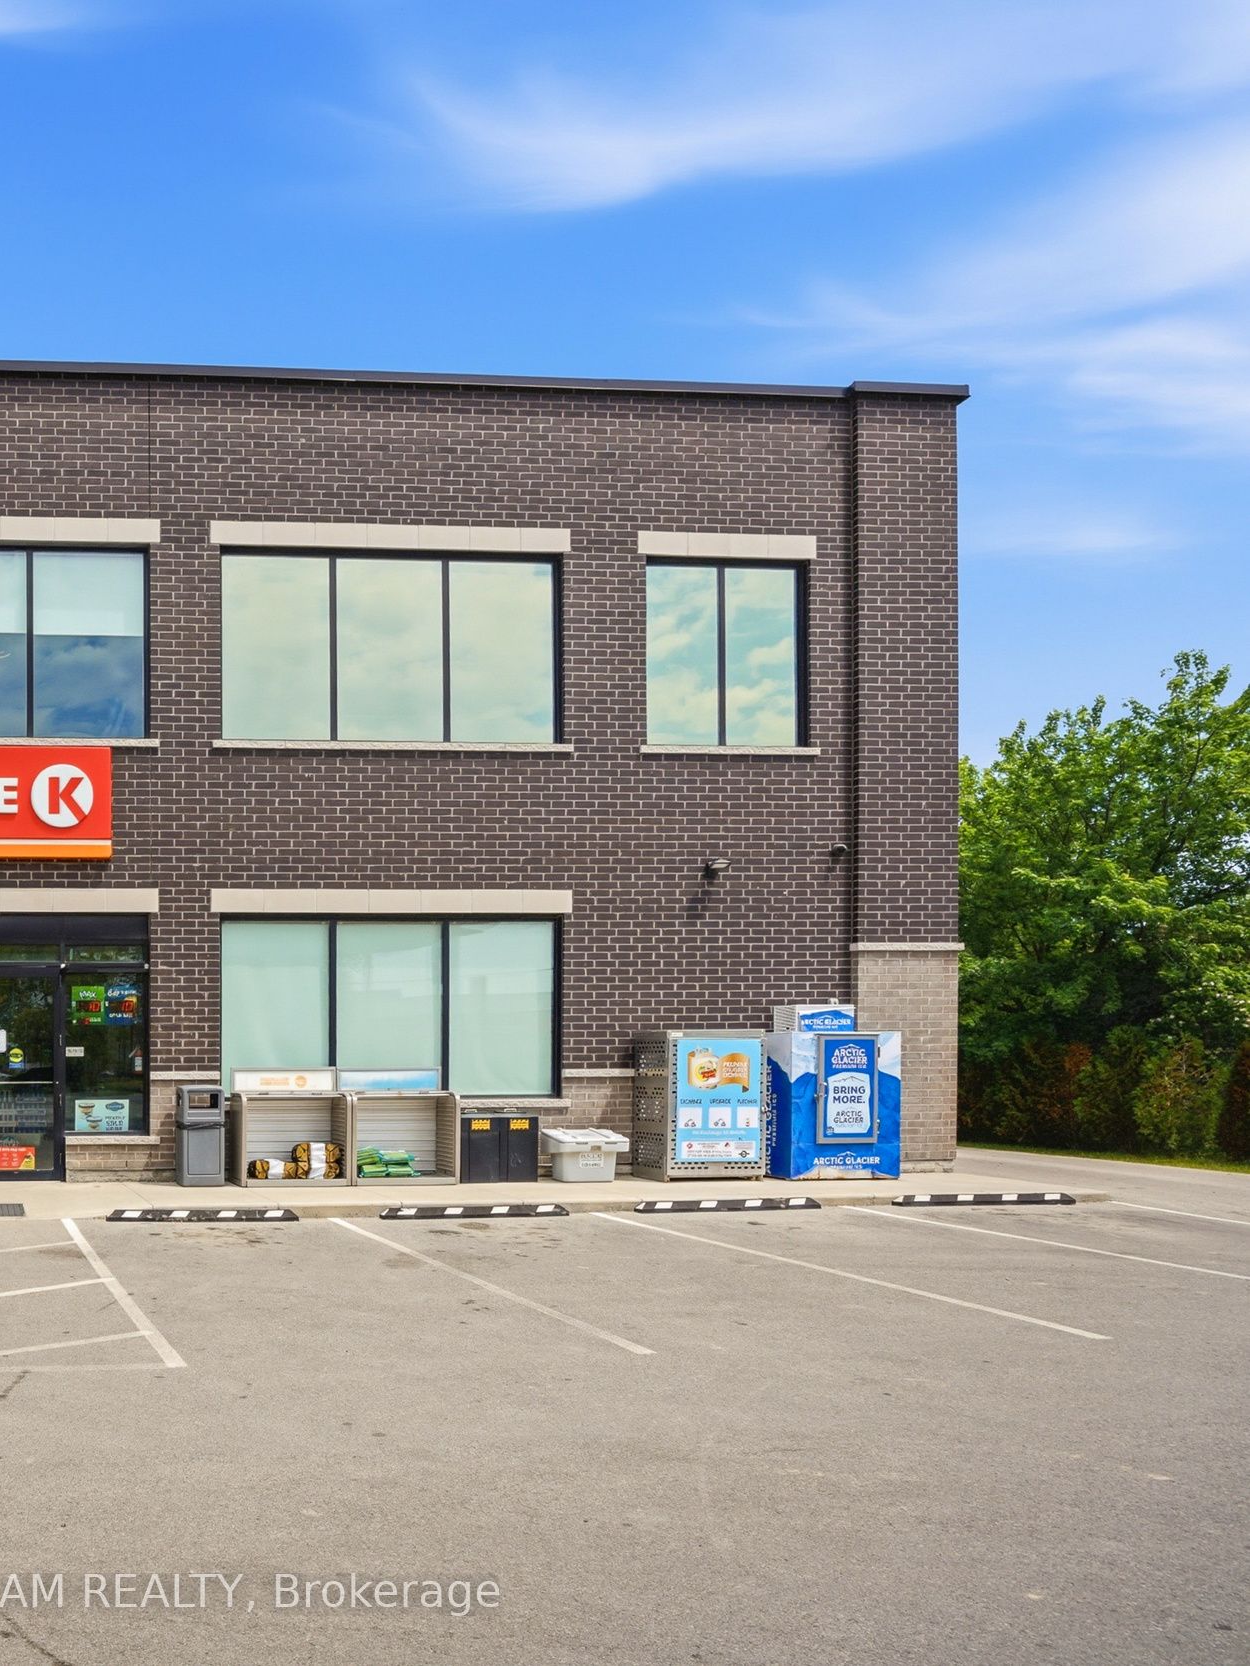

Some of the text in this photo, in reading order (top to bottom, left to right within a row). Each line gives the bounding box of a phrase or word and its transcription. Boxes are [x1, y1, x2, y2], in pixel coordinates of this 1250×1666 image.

[47, 776, 88, 825] K
[832, 1056, 867, 1064] GLACIER
[833, 1086, 866, 1094] BRING
[833, 1096, 866, 1104] MORE.
[845, 1156, 881, 1164] GLACIER
